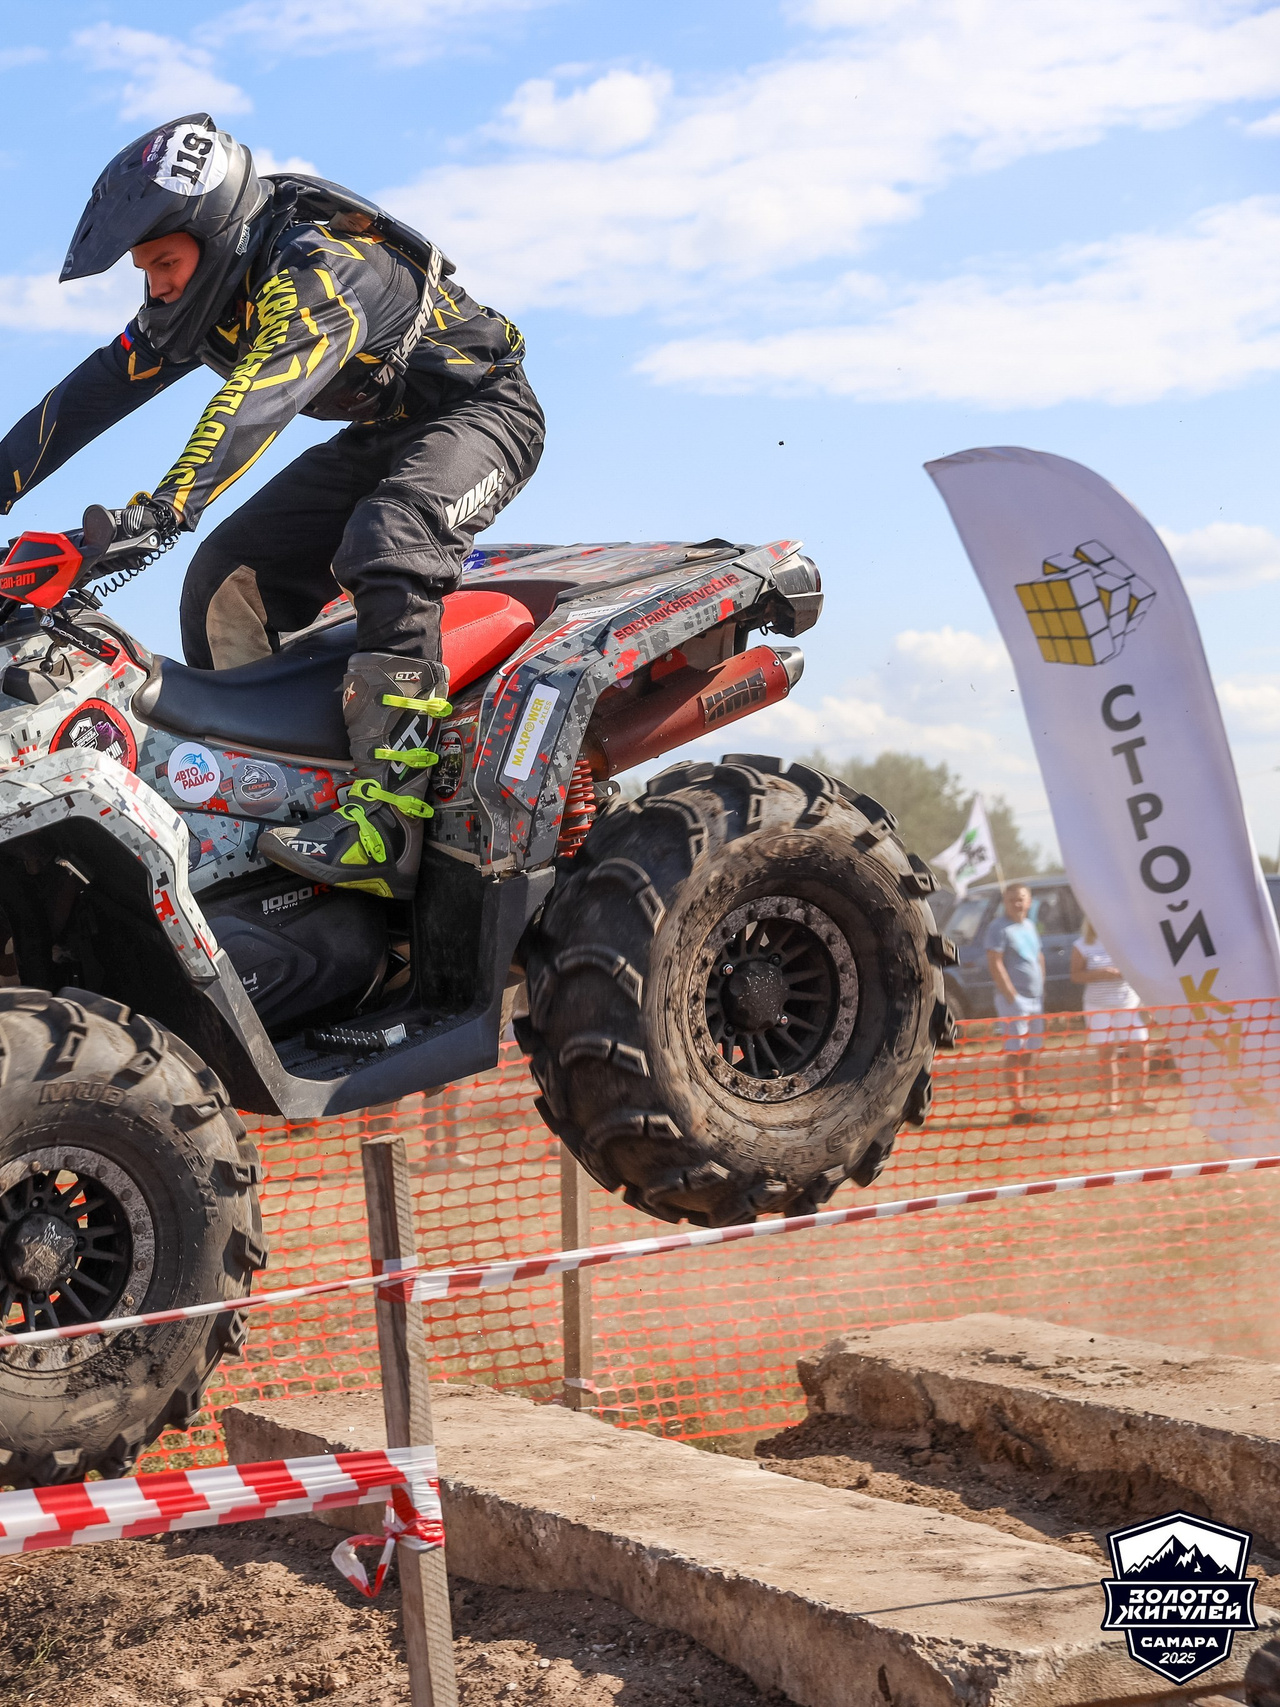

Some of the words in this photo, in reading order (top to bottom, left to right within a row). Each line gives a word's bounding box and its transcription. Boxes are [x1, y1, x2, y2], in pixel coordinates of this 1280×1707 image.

[171, 132, 213, 186] 119
[0, 572, 36, 589] can-am
[394, 671, 423, 681] GTX
[538, 700, 552, 726] AXLES
[173, 766, 199, 784] АВТО
[182, 771, 216, 790] РАДИО
[287, 840, 327, 856] GTX
[261, 883, 331, 912] 1000R
[39, 1080, 126, 1108] MUD
